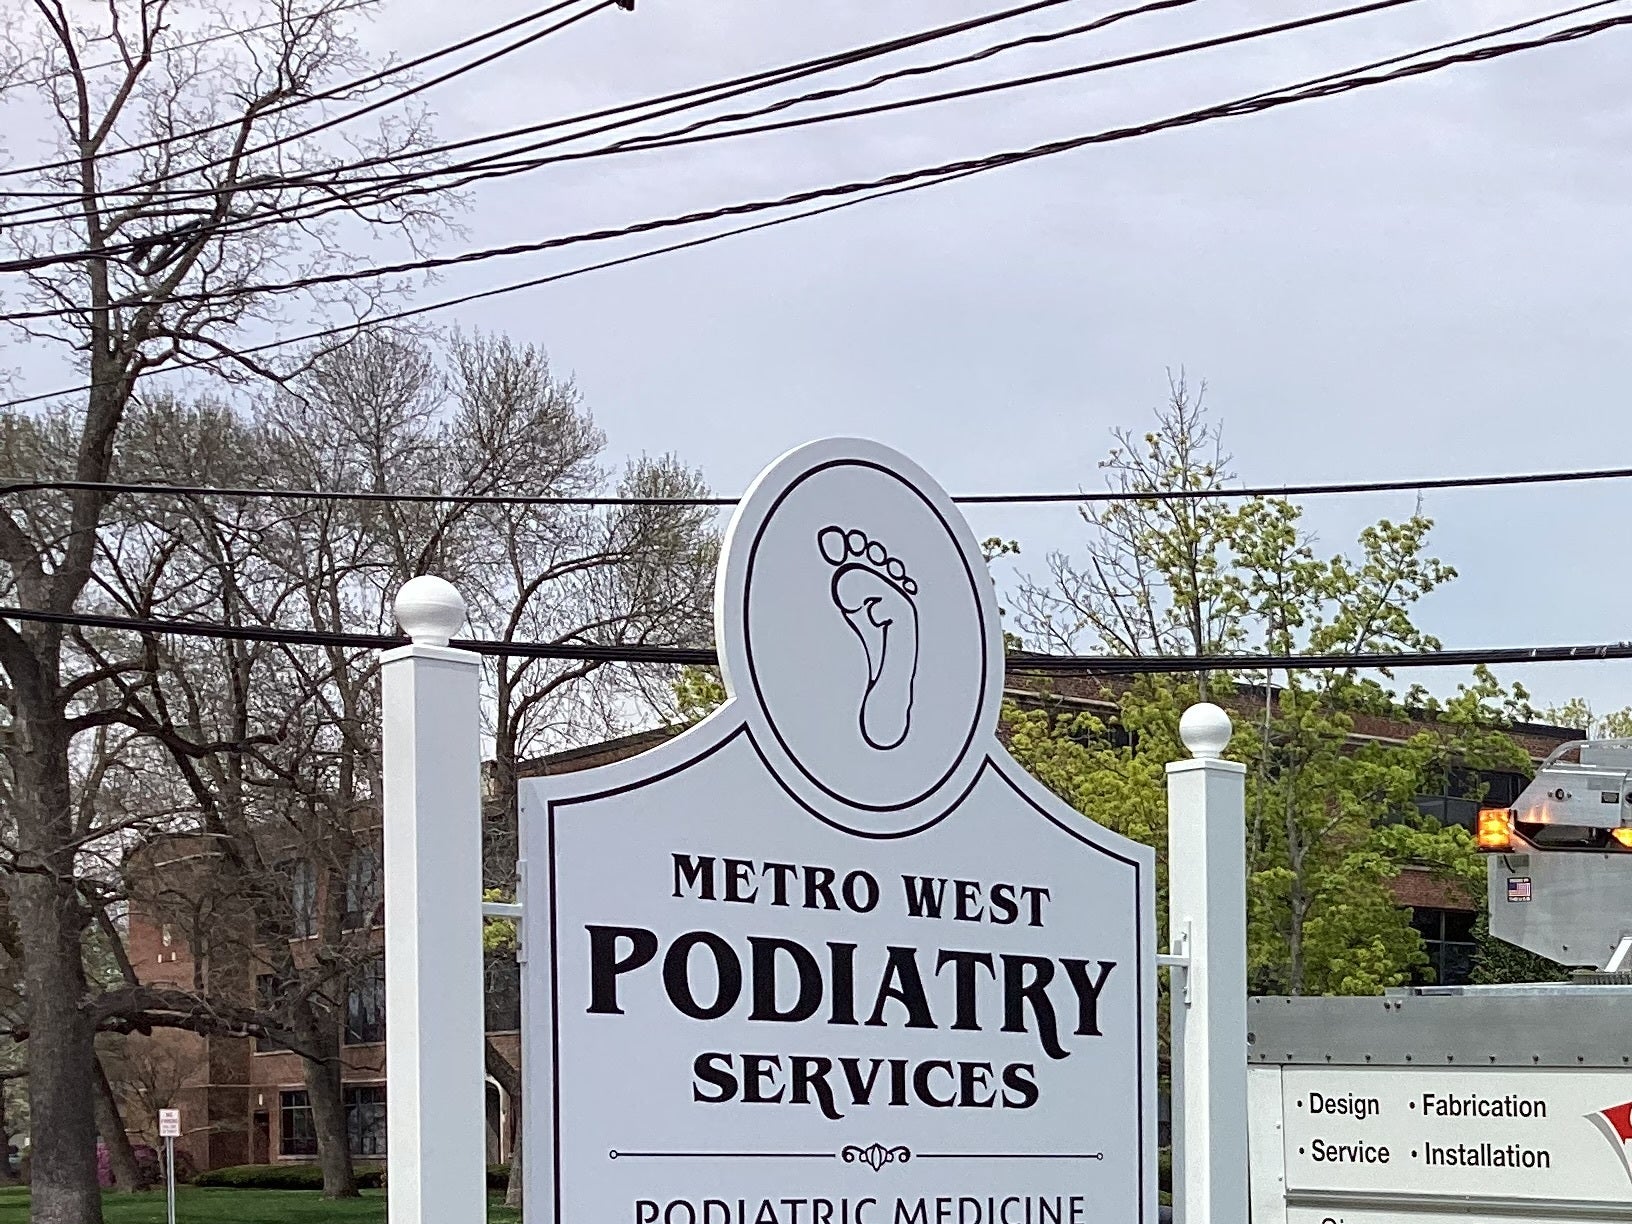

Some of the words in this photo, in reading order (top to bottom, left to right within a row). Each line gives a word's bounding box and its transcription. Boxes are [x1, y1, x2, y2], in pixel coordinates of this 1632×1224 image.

[671, 852, 880, 914] METRO
[900, 874, 1051, 928] WEST
[584, 924, 1117, 1060] PODIATRY
[692, 1052, 1039, 1121] SERVICES
[1309, 1092, 1380, 1121] Design
[1423, 1093, 1547, 1118] Fabrication
[1311, 1138, 1390, 1164] Service
[1425, 1141, 1550, 1169] Installation
